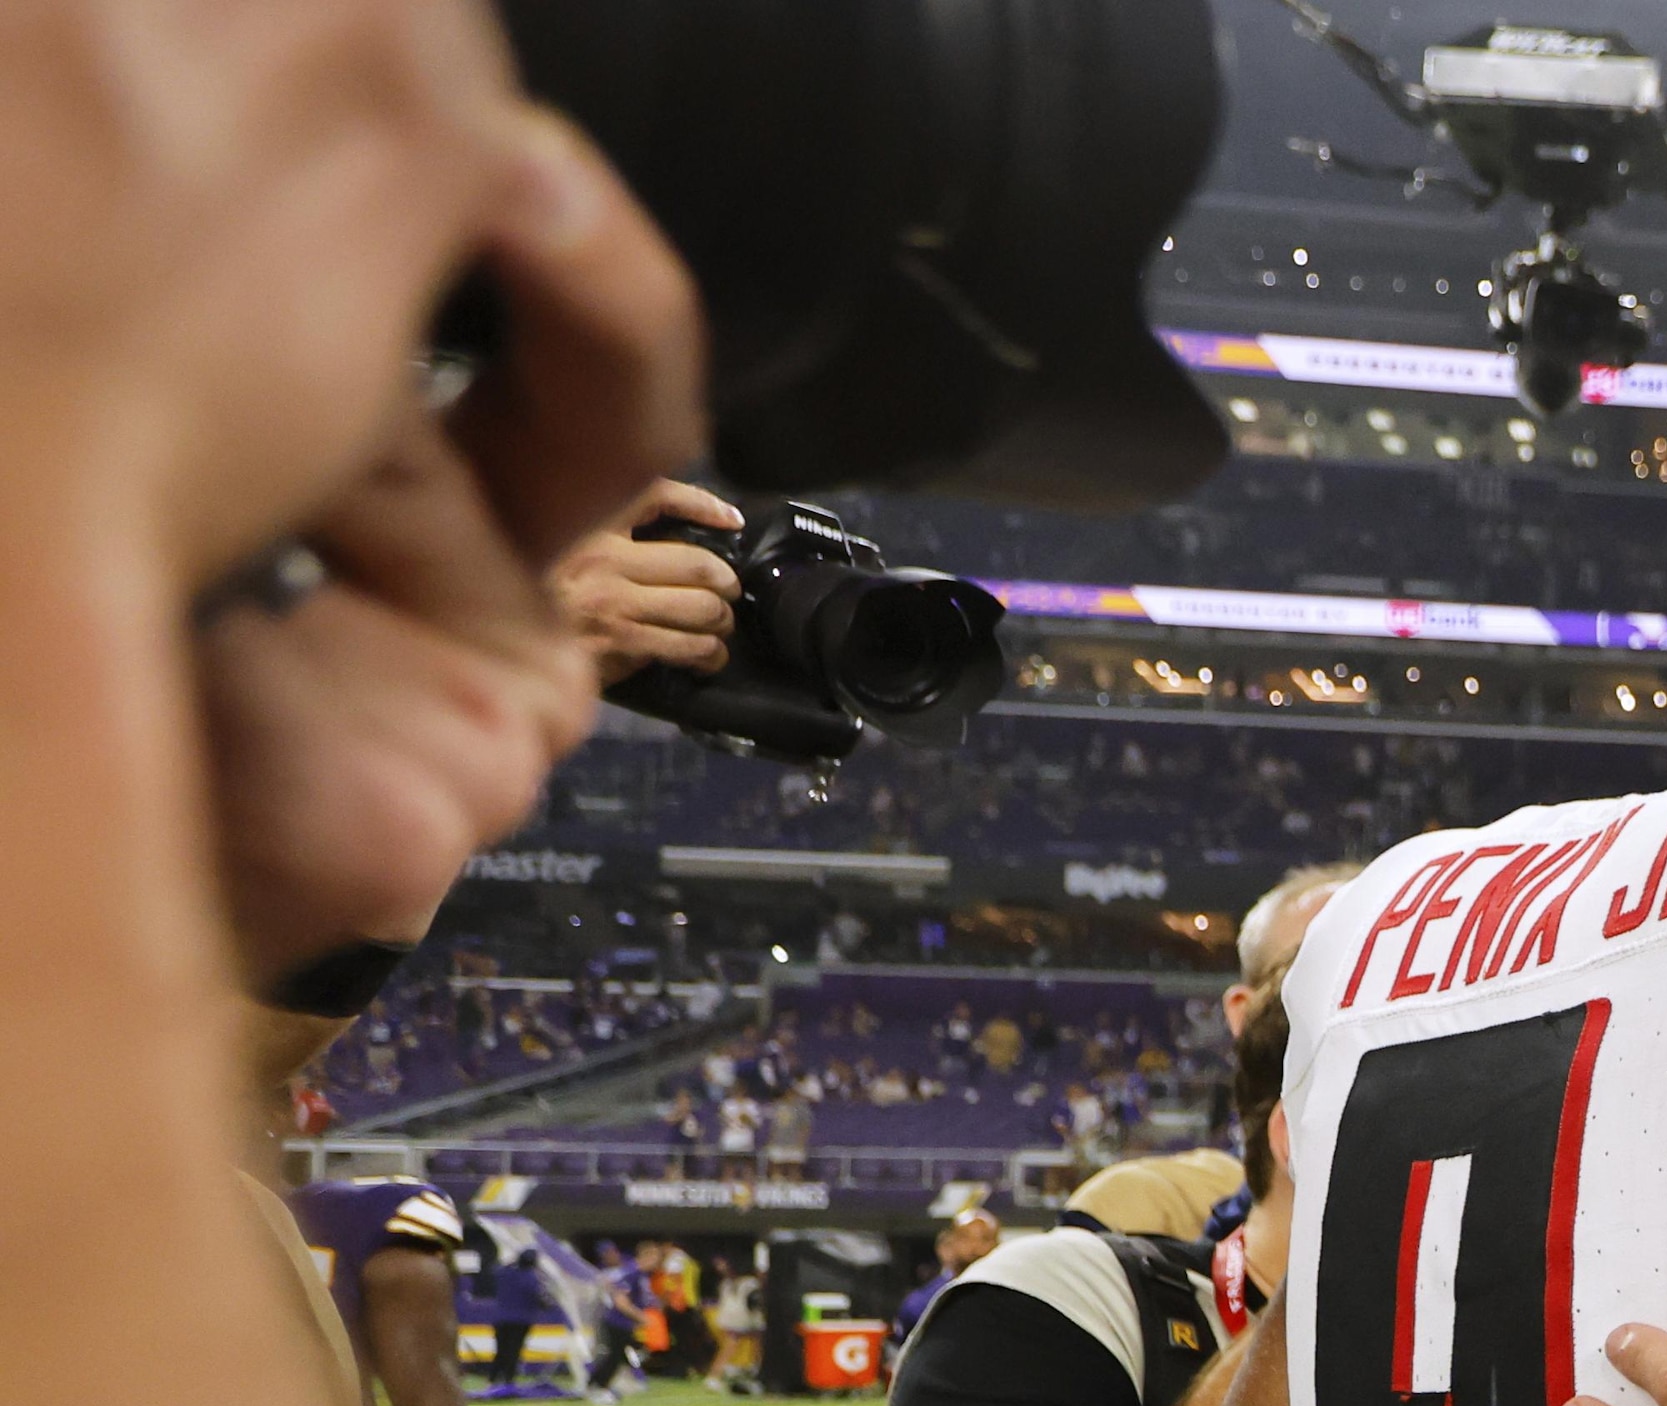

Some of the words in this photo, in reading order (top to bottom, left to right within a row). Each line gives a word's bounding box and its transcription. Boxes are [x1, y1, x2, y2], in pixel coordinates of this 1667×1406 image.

[793, 513, 843, 543] Nikon
[1339, 803, 1645, 1009] PENIX
[833, 1335, 870, 1373] G
